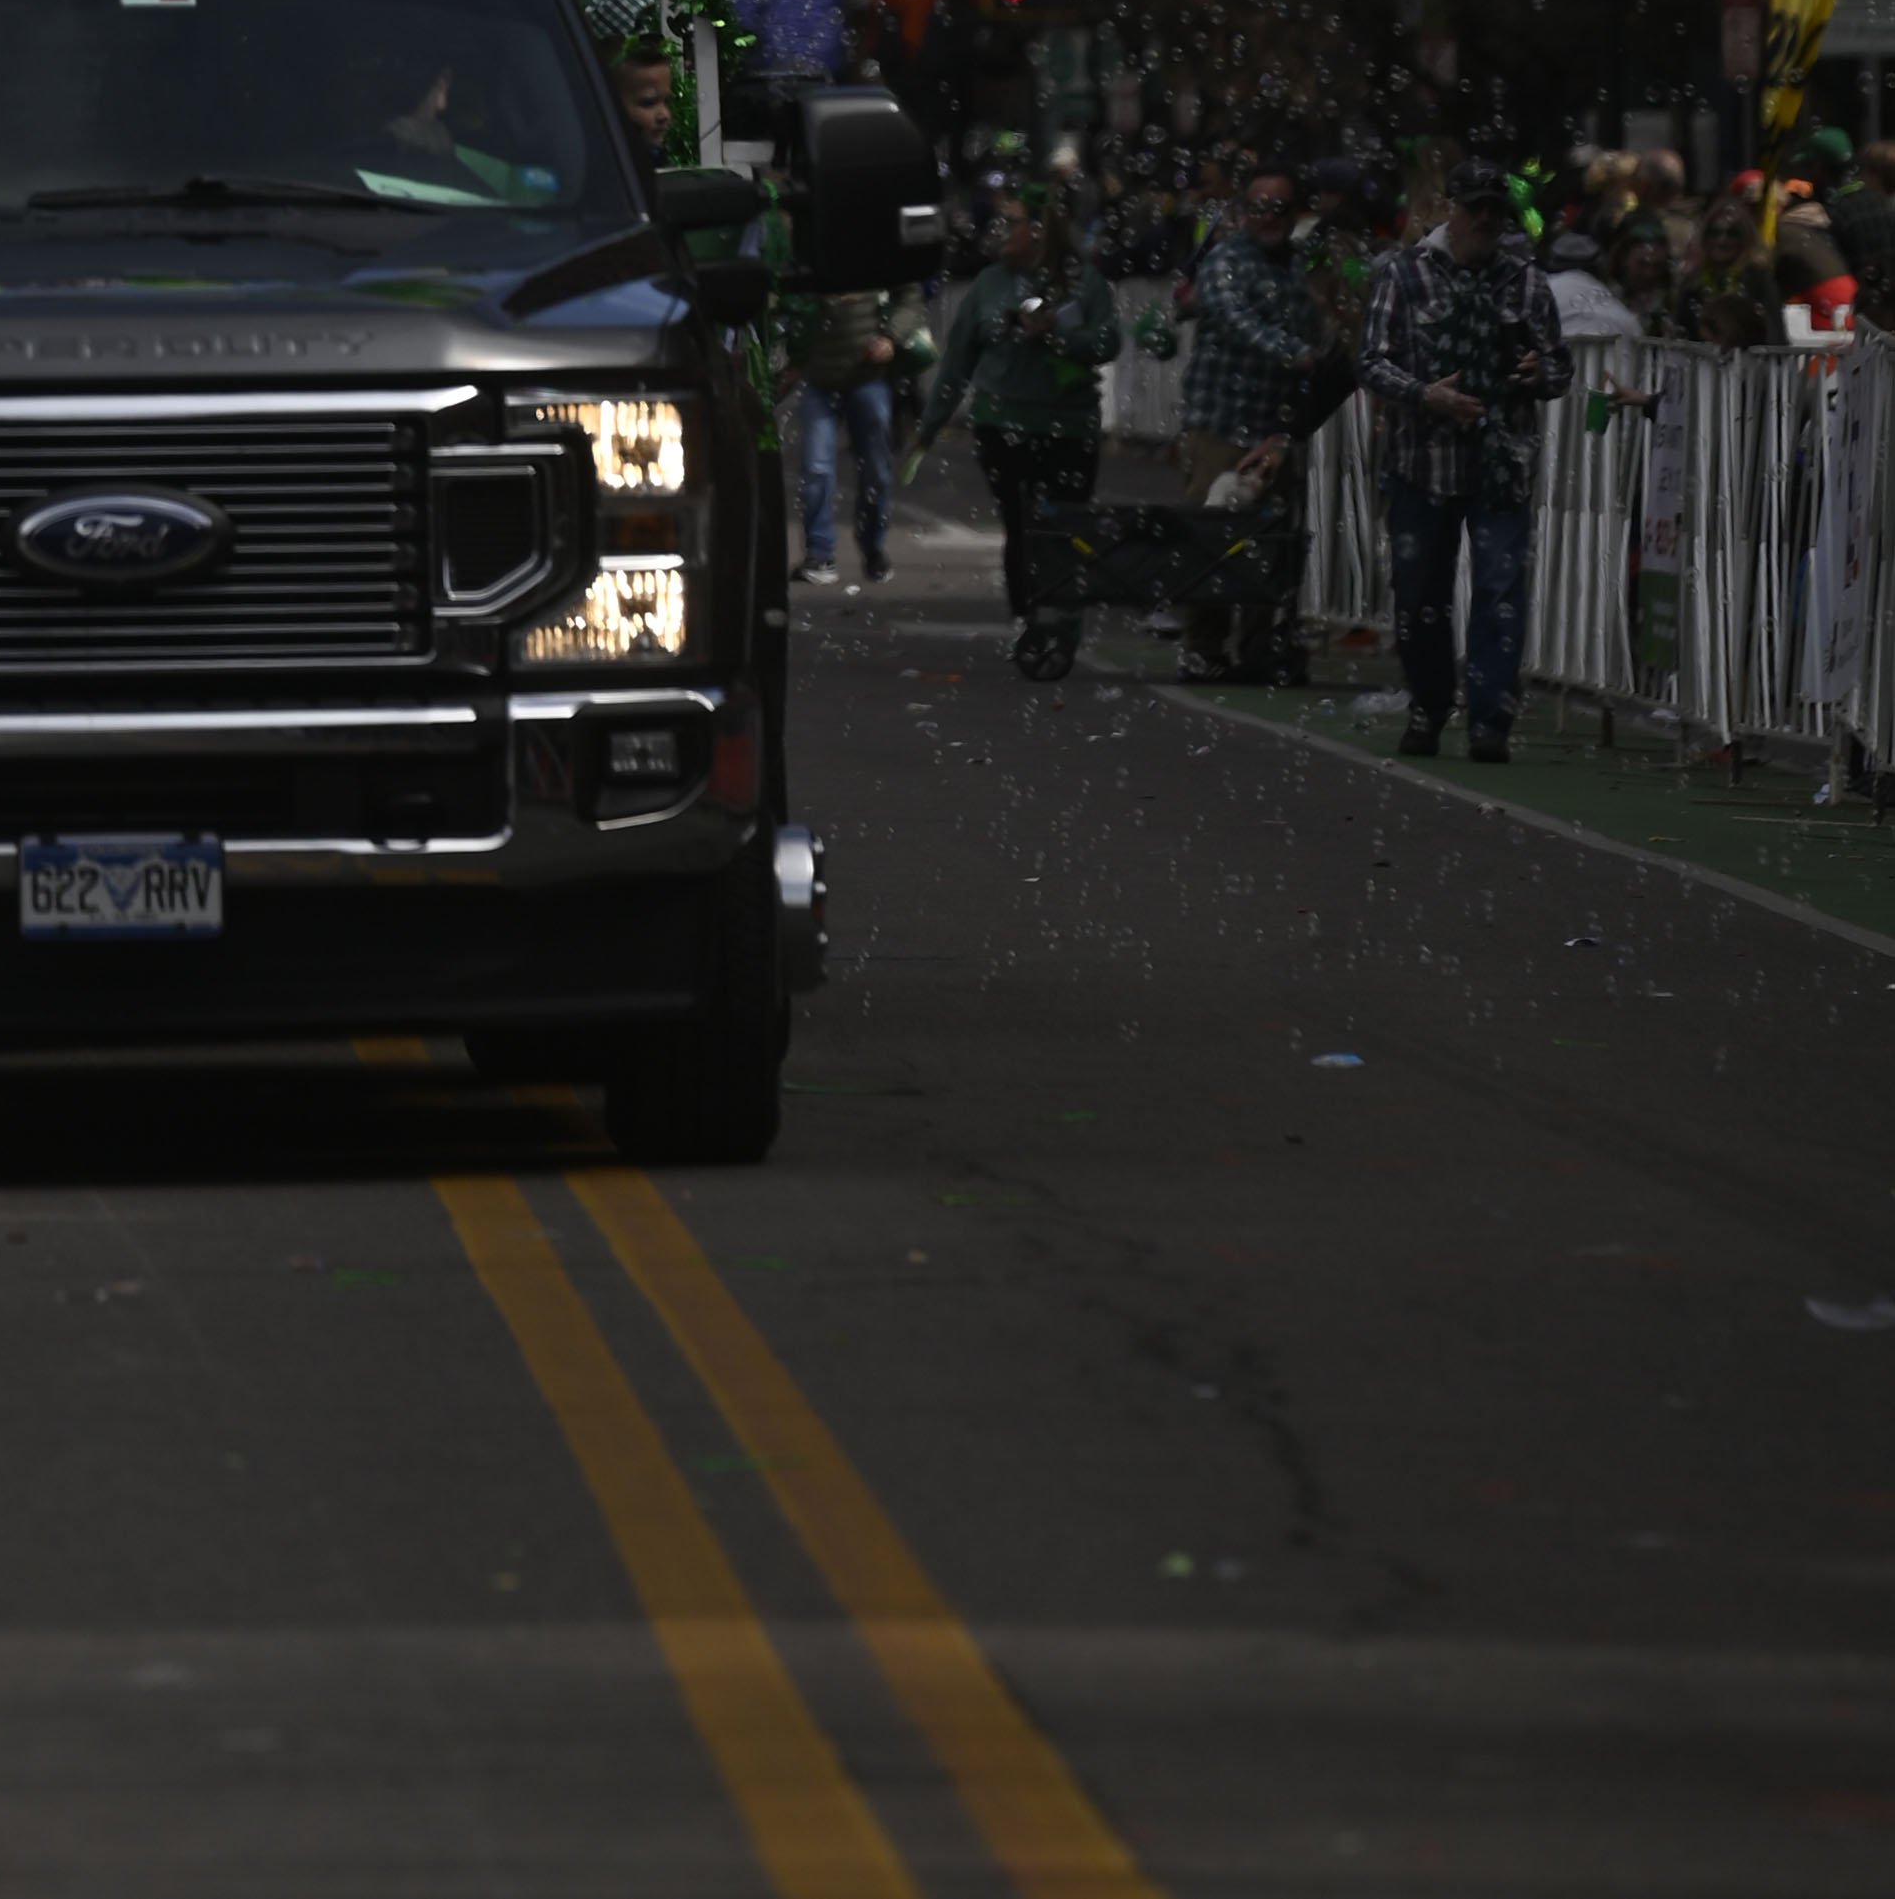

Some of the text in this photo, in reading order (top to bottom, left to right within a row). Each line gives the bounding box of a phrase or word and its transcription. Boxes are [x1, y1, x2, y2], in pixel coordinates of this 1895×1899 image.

[65, 513, 171, 559] Ford
[31, 864, 212, 914] 622 RRV
